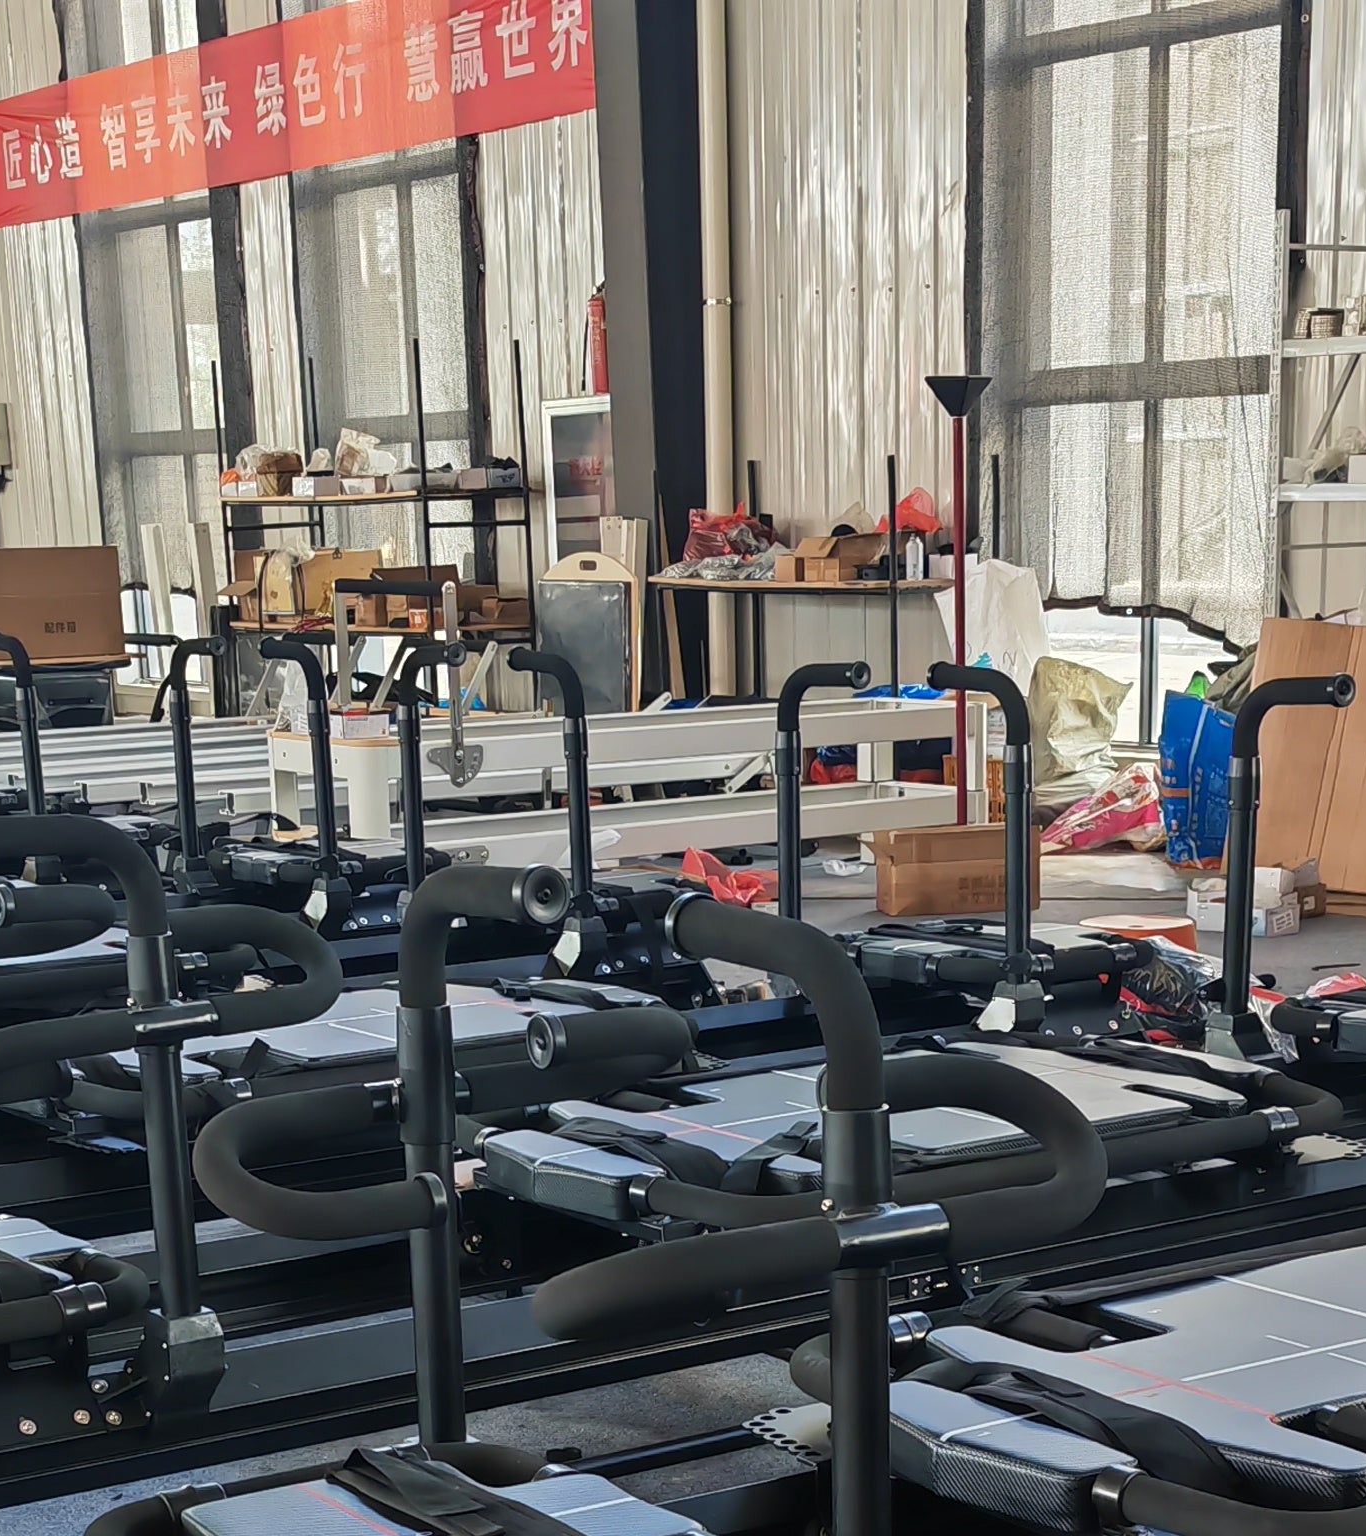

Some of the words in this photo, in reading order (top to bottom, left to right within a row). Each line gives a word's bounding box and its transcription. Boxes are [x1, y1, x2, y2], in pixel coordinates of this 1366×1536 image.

[1, 111, 84, 190] 匠心造
[98, 75, 233, 171] 智享未来
[253, 42, 367, 137] 绿色行
[402, 0, 589, 103] 慧赢世界
